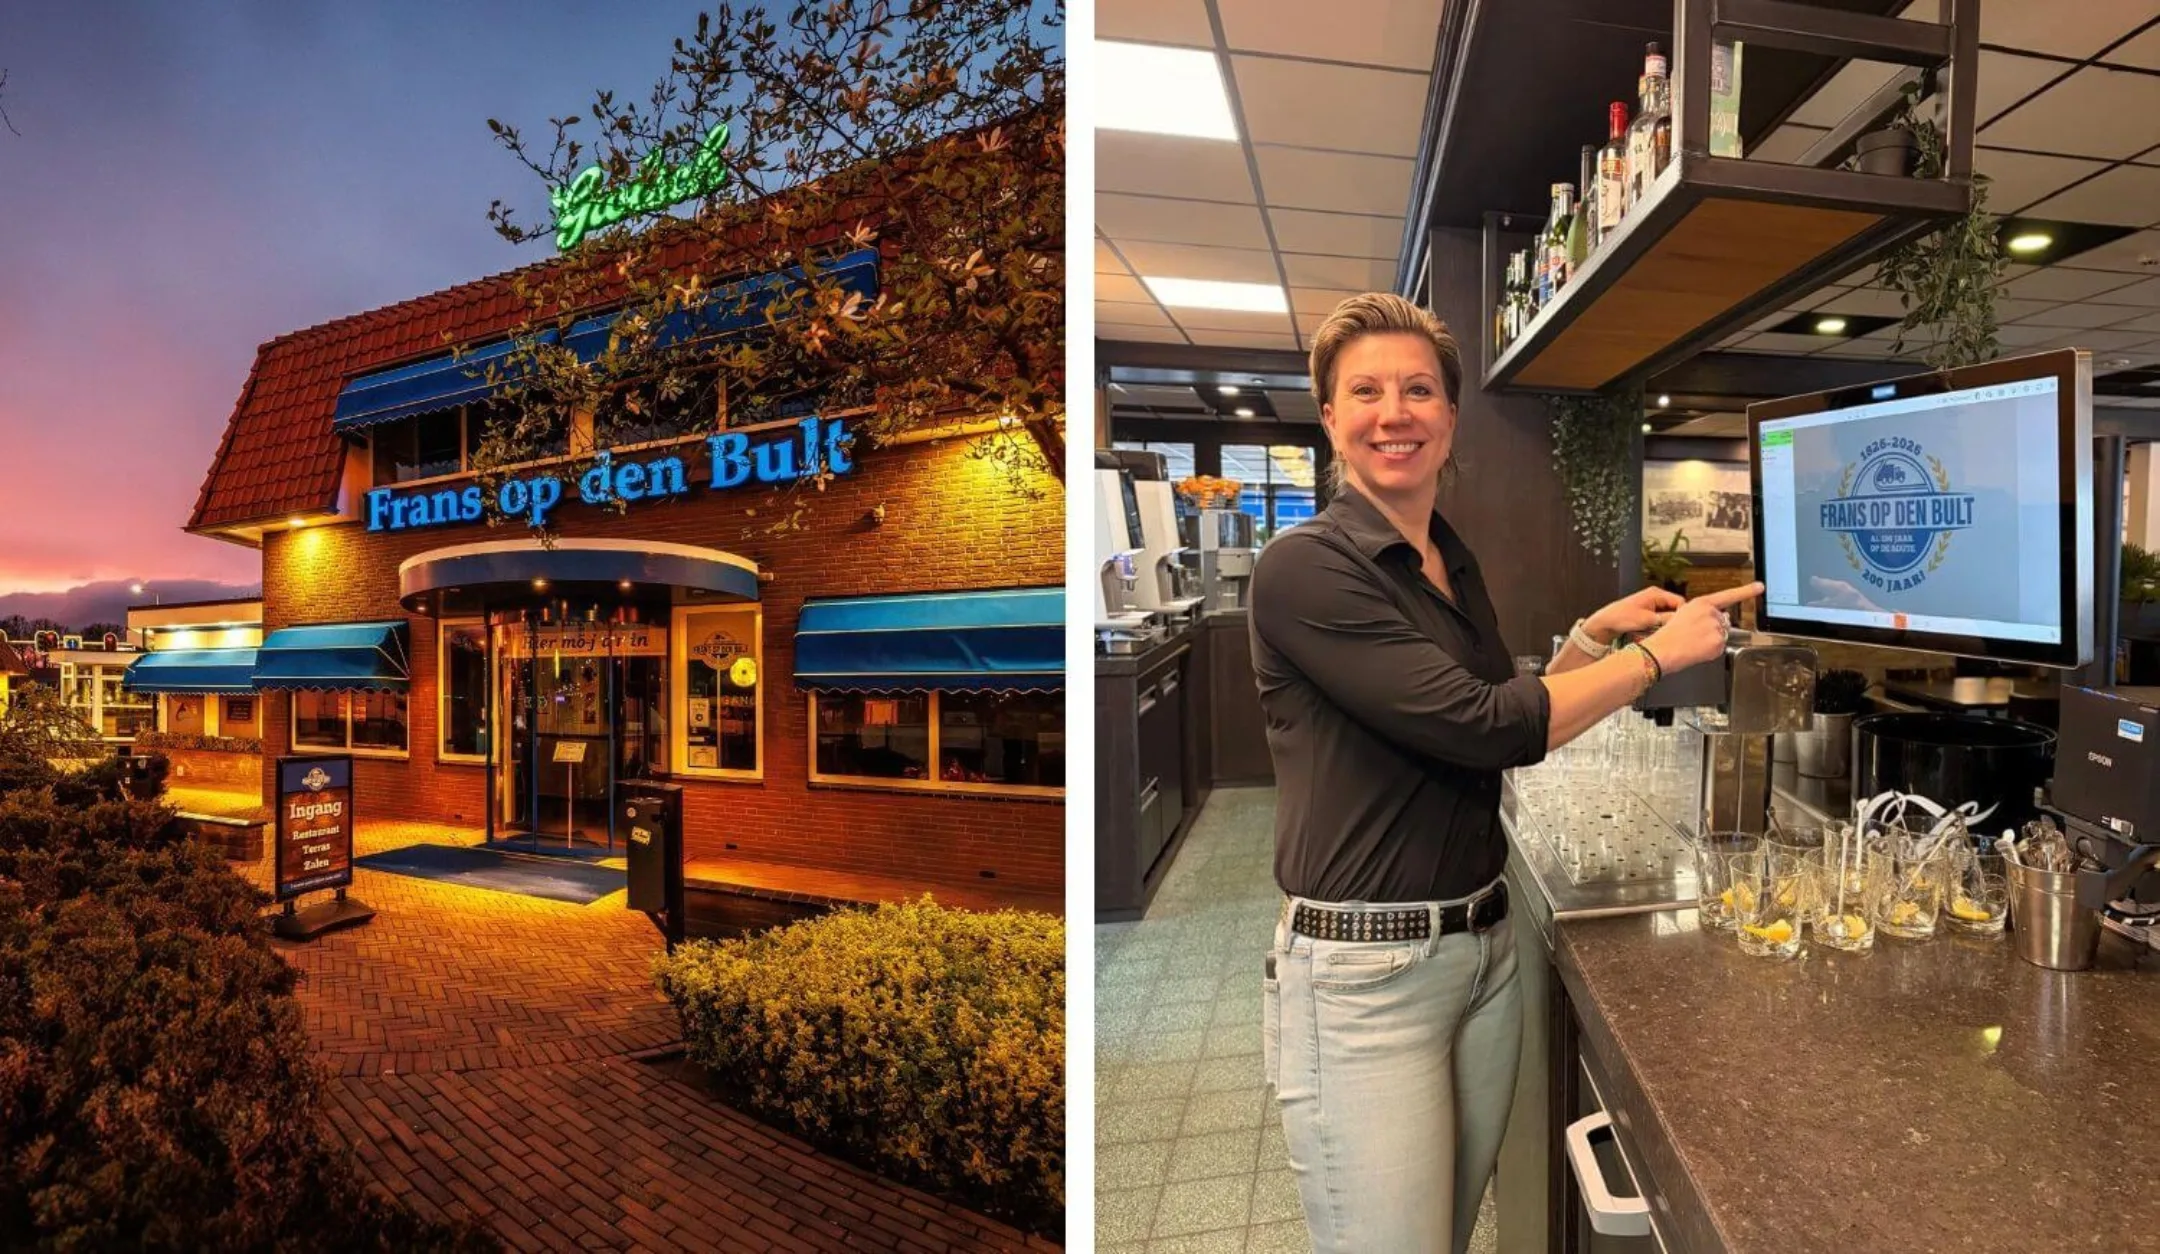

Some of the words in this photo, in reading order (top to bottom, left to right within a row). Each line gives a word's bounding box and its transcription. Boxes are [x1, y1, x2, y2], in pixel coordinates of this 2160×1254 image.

[367, 485, 482, 532] Frans
[500, 477, 561, 526] op
[580, 449, 688, 503] den
[707, 416, 854, 490] Bult
[1820, 501, 1867, 528] FRANS
[1870, 501, 1891, 527] OP
[1894, 499, 1928, 526] DEN
[1931, 496, 1975, 526] BULT
[1862, 569, 1883, 588] 200
[1887, 570, 1926, 593] JAAR!
[630, 630, 649, 648] in
[2087, 751, 2112, 768] EPSON
[289, 801, 343, 820] Ingang
[292, 825, 340, 841] Restaurant
[302, 843, 331, 854] Terras
[303, 858, 329, 871] Zalen
